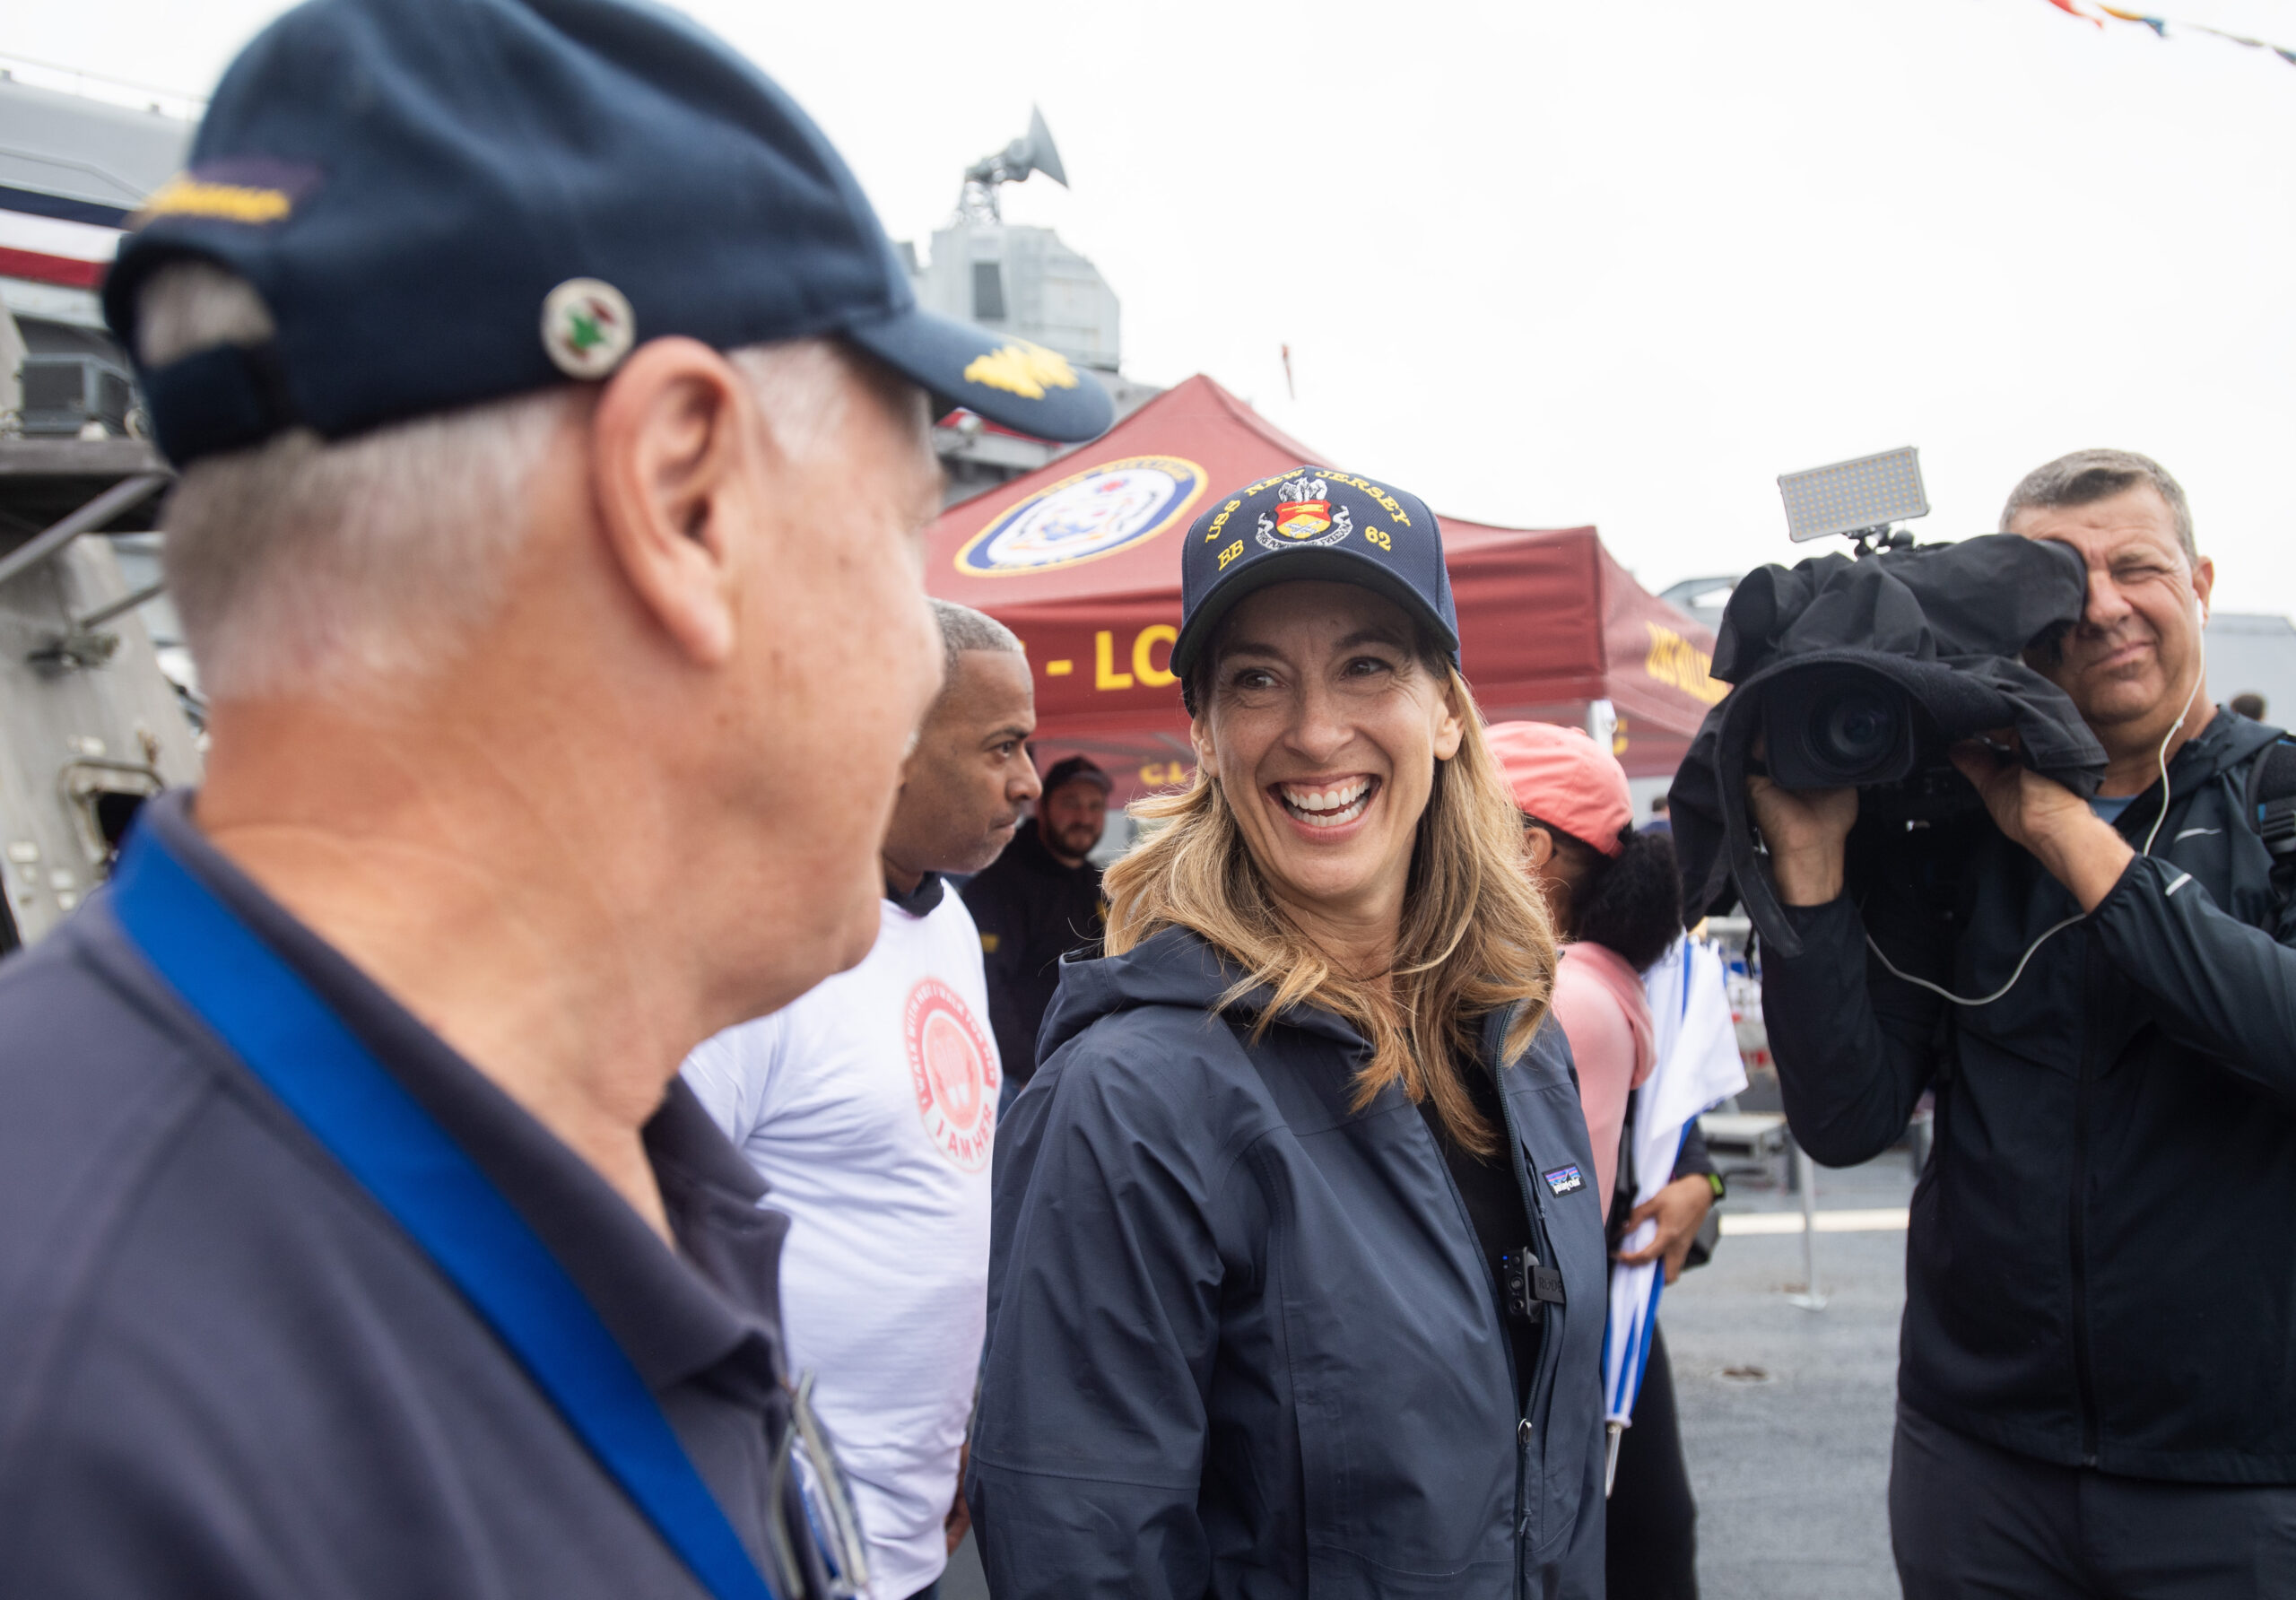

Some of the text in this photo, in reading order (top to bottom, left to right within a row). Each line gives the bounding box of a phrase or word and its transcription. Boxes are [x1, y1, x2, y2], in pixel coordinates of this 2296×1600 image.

[1205, 500, 1241, 543] USS
[1244, 469, 1305, 497] NEW
[1315, 470, 1411, 527] JERSEY
[1217, 526, 1391, 571] BB 62
[936, 1118, 944, 1138] I
[947, 1131, 973, 1163] AM
